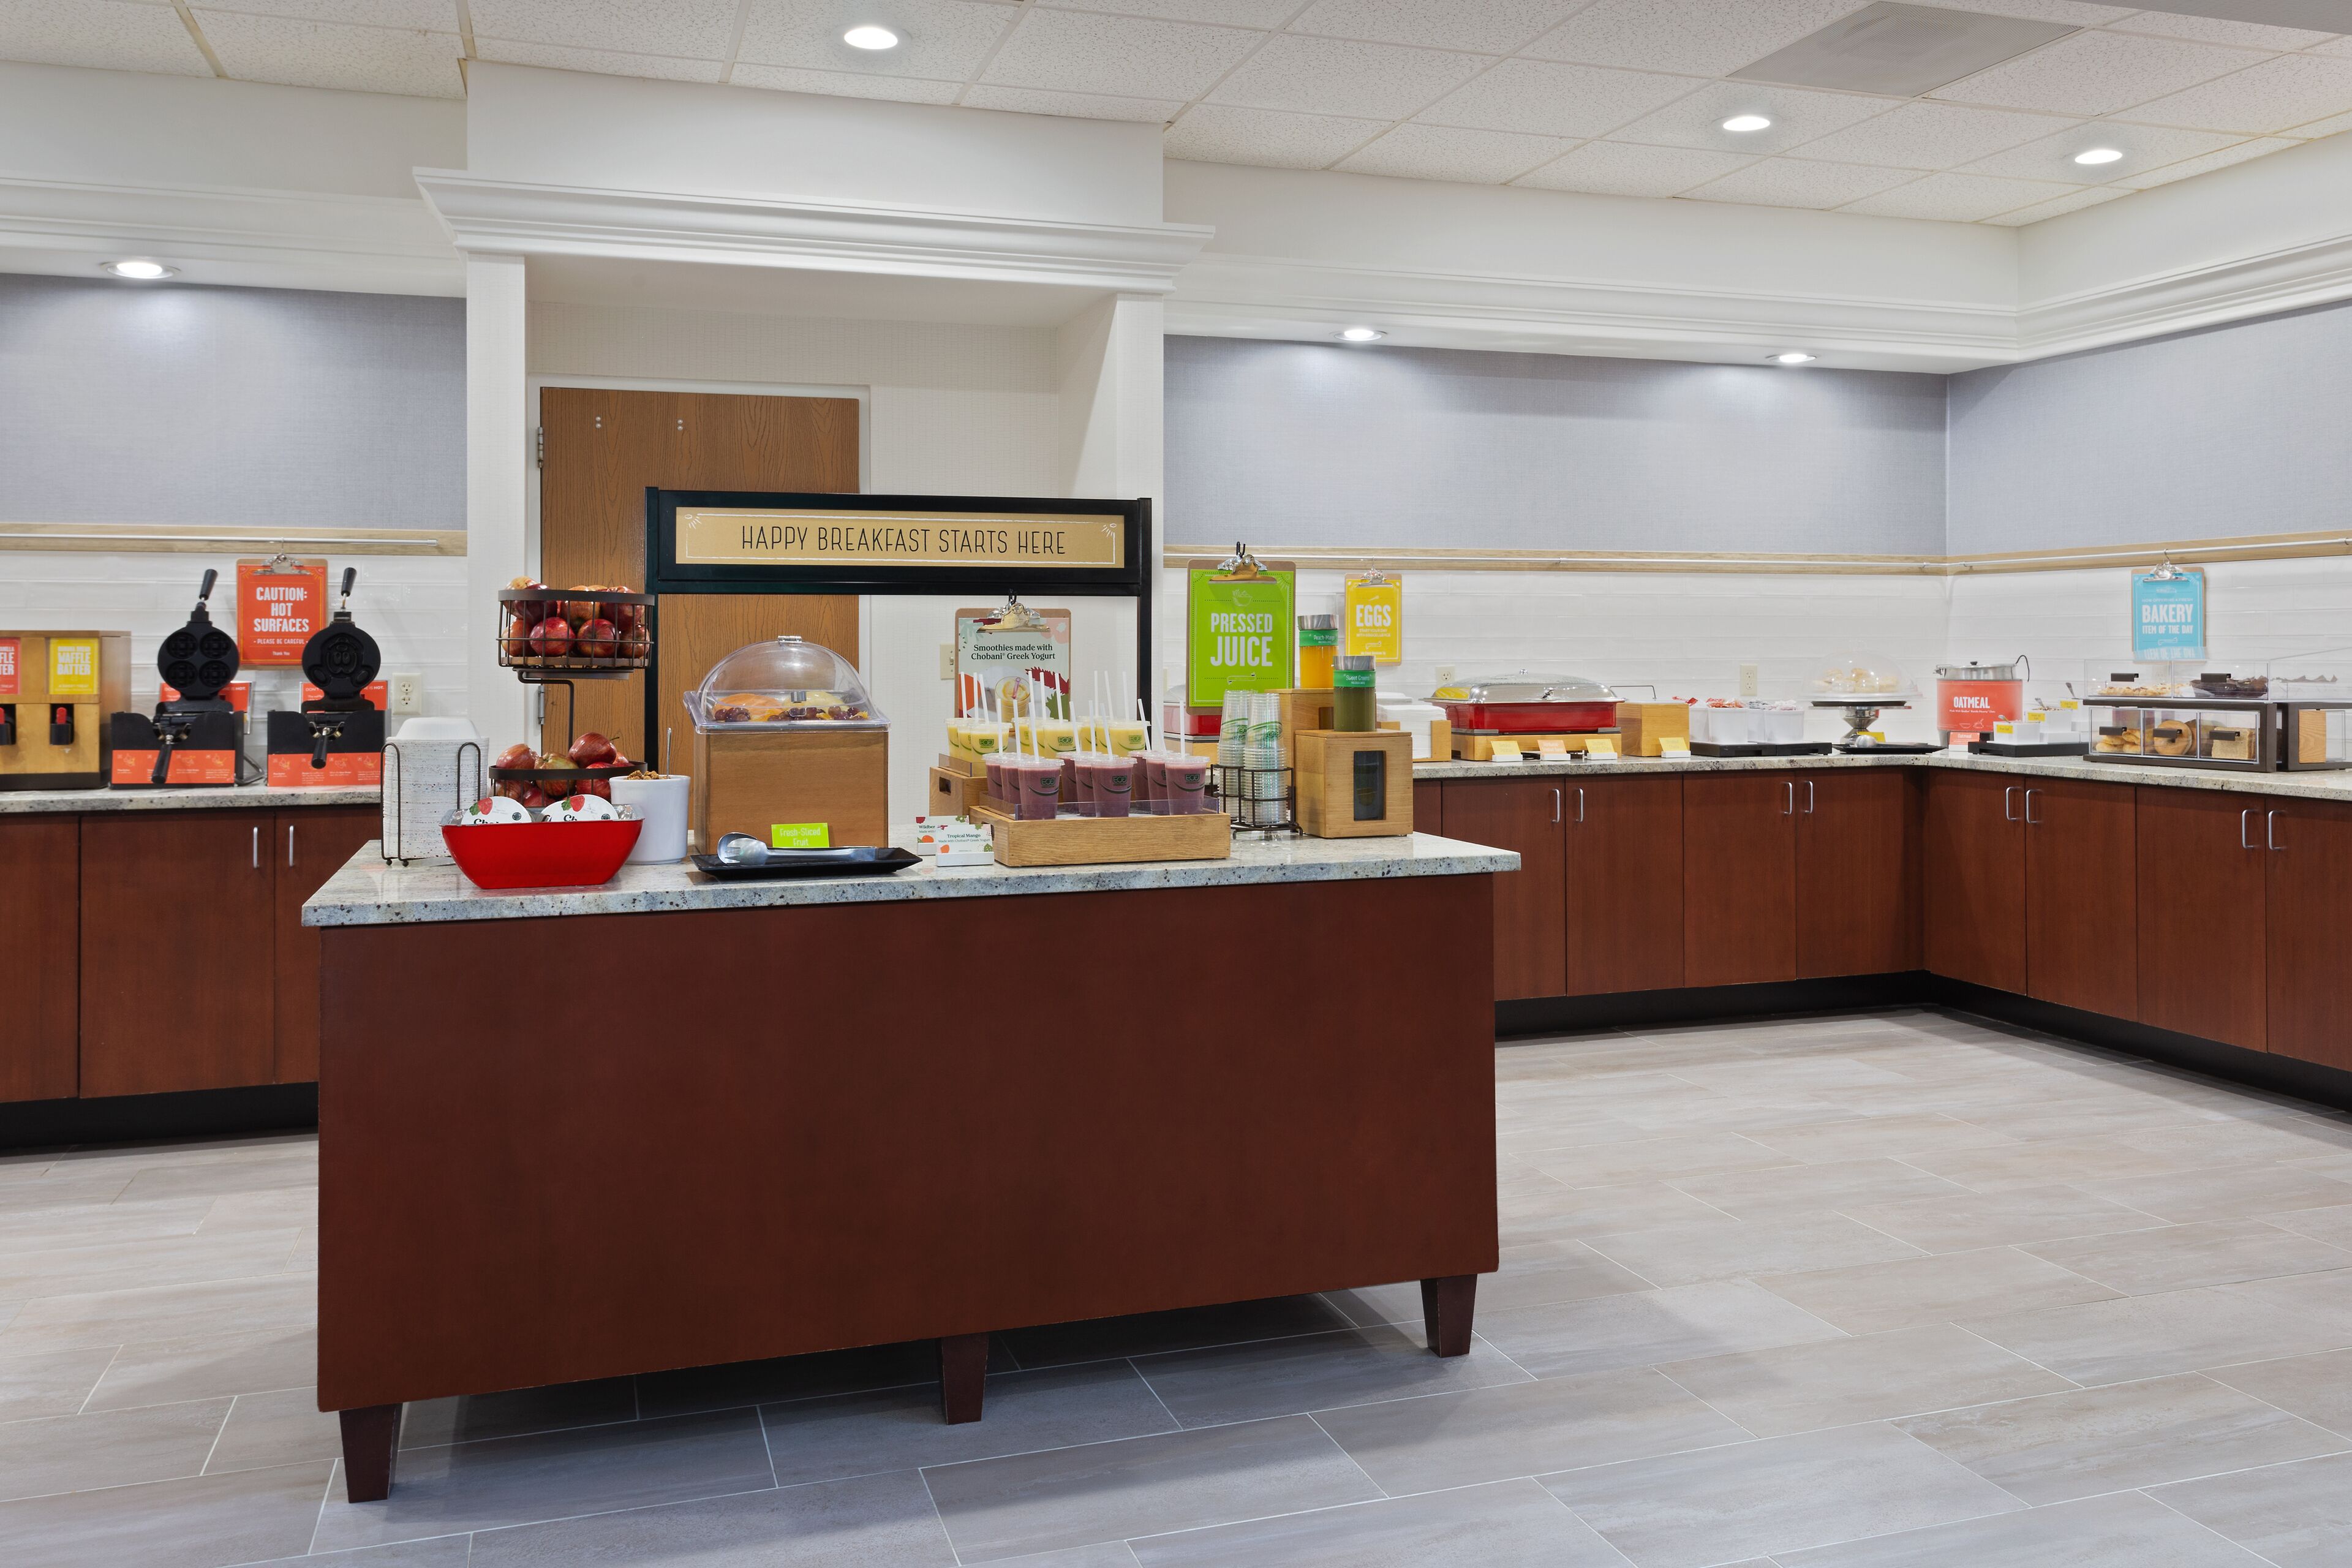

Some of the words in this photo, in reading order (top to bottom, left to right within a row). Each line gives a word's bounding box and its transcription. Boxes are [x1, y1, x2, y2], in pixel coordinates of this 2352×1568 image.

[742, 525, 808, 551] HAPPY
[818, 527, 930, 552] BREAKFAST
[938, 529, 1008, 554] STARTS
[1018, 530, 1065, 554] HERE
[256, 587, 307, 601] CAUTION:
[271, 603, 293, 616] HOT
[1356, 604, 1391, 627] EGGS
[2142, 604, 2193, 623] BAKERY
[254, 618, 309, 632] SURFACES
[1210, 612, 1273, 633] PRESSED
[2142, 625, 2157, 634] ITEM
[2158, 625, 2166, 634] OF
[2168, 625, 2180, 634] THE
[2181, 625, 2193, 634] DAY
[58, 652, 91, 663] WAFFLE
[1210, 636, 1273, 666] JUICE
[57, 664, 91, 675] BATTER
[1953, 696, 1990, 709] OATMEAL
[779, 827, 821, 837] Fresh-Sliced
[793, 838, 809, 846] Fruit
